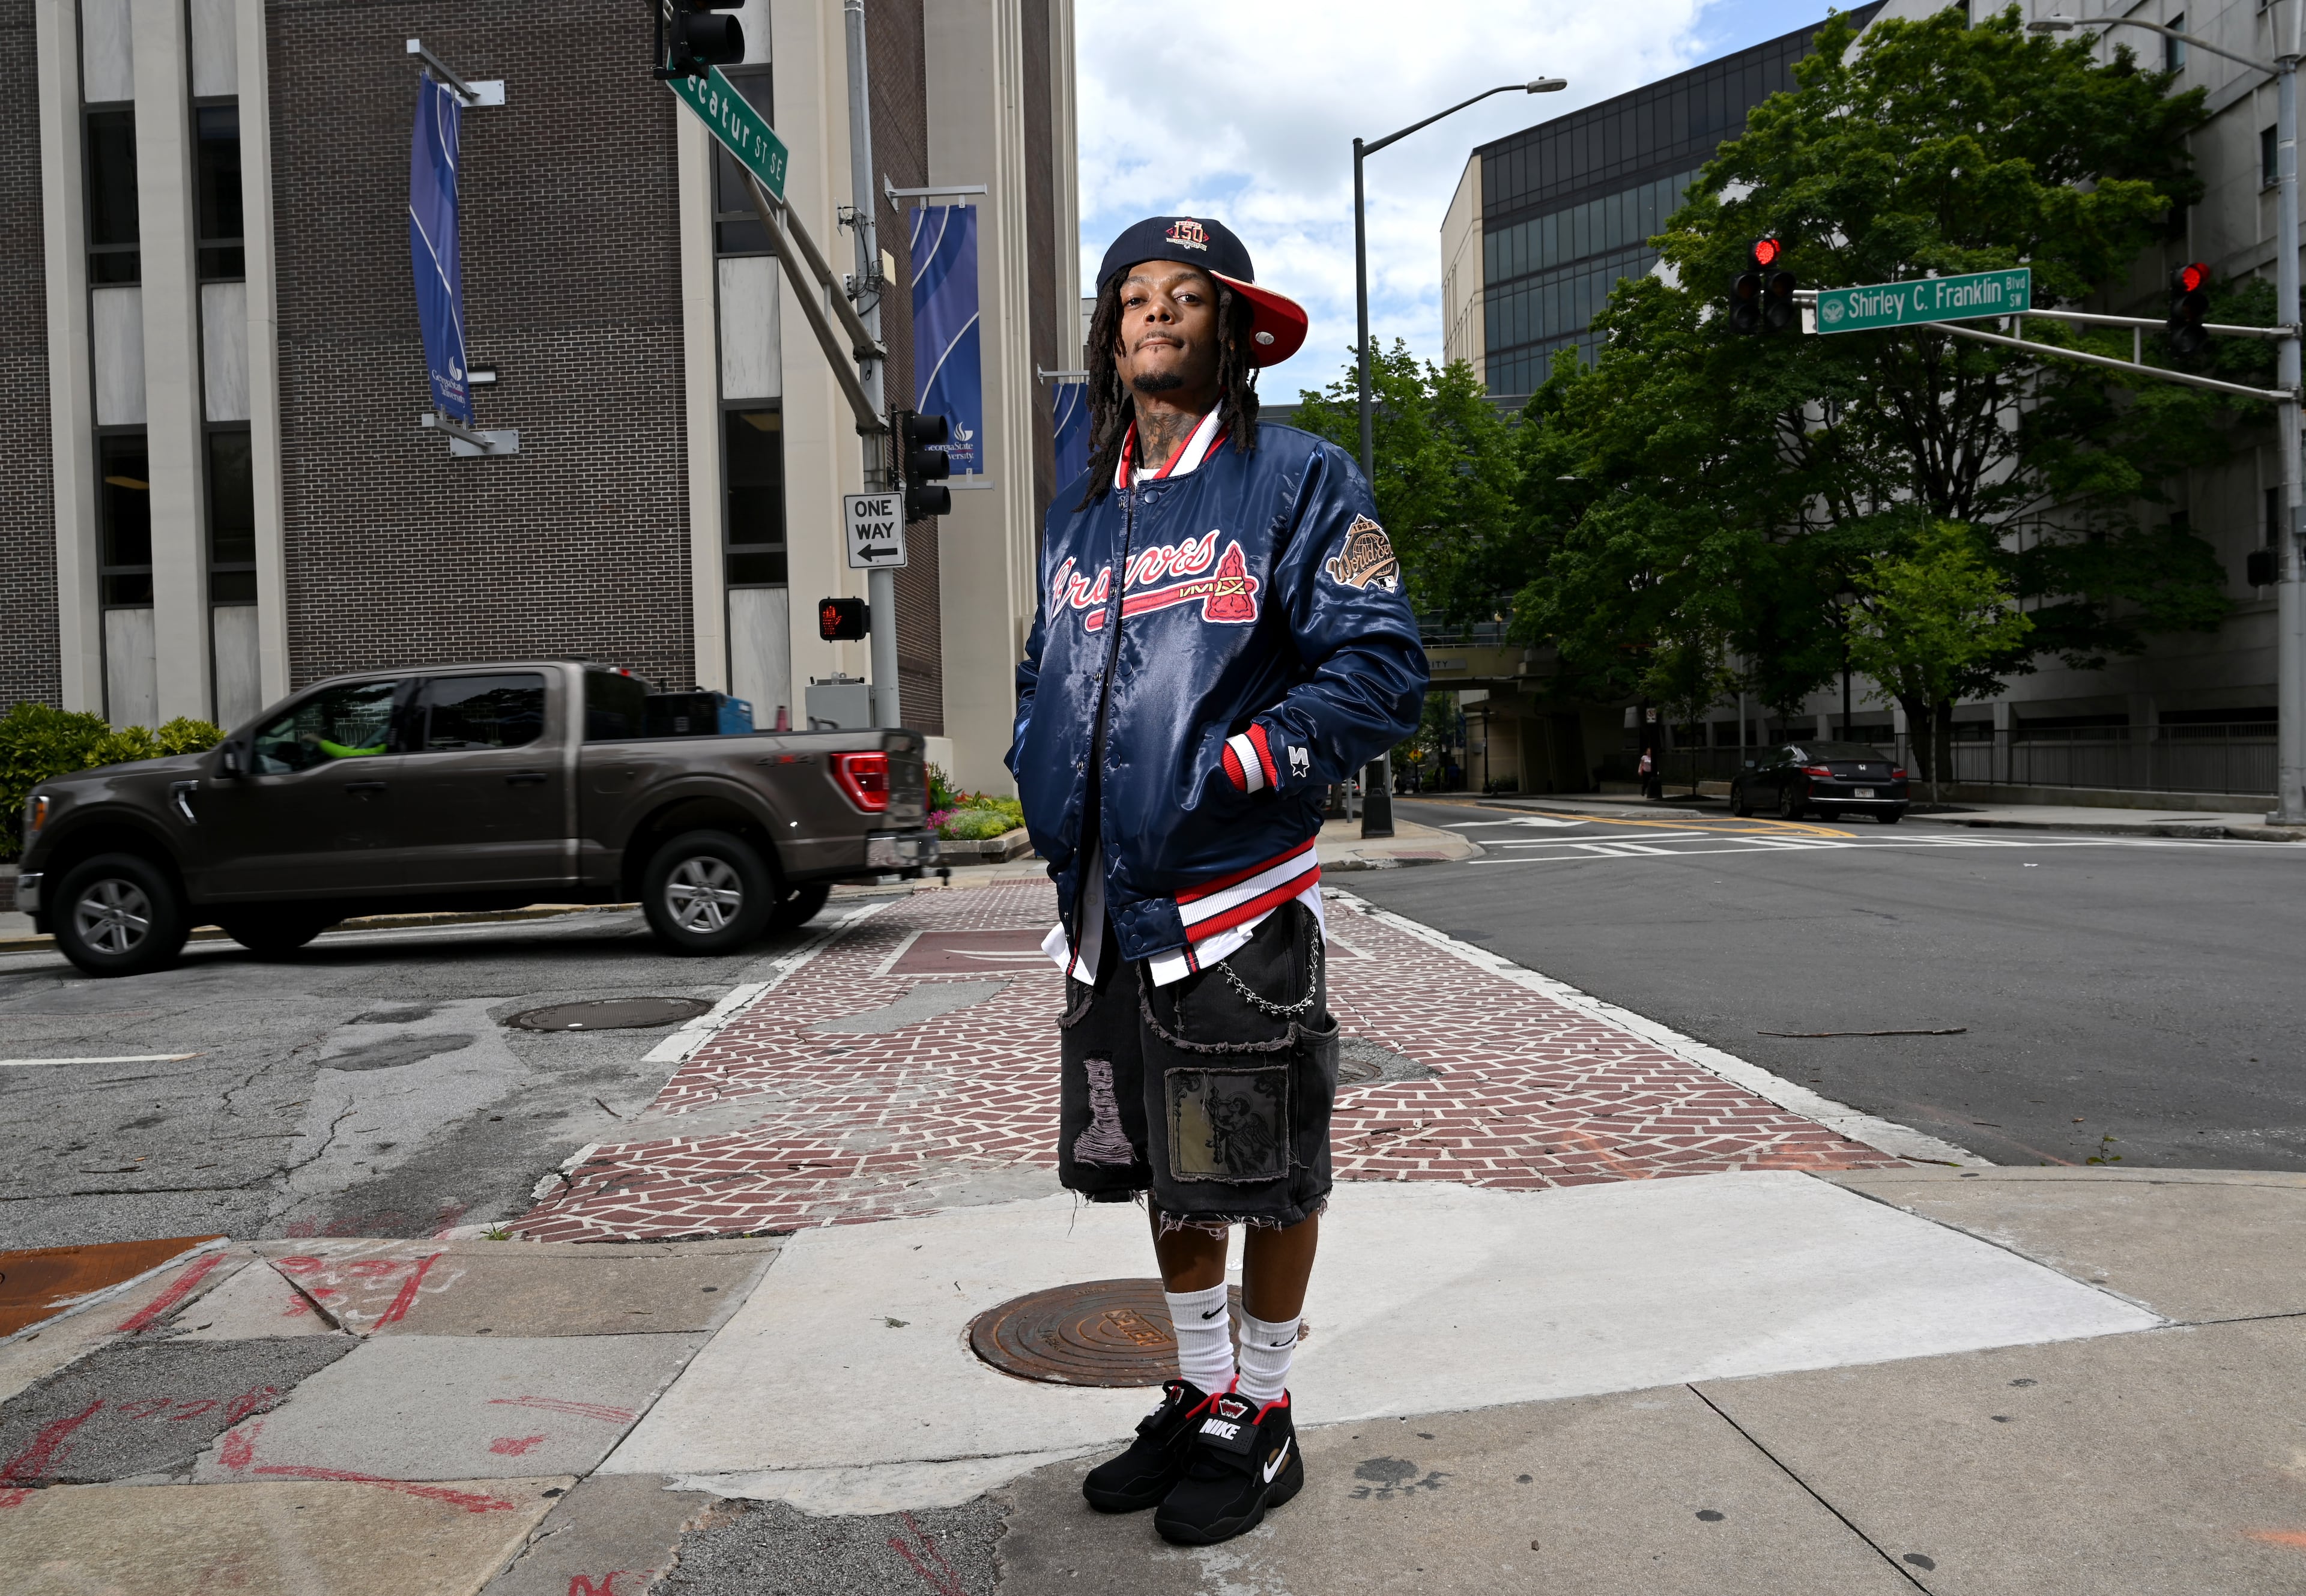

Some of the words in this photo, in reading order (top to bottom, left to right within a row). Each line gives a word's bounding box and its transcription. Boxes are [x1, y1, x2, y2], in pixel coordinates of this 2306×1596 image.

[688, 74, 749, 148] ecatur
[754, 135, 767, 164] ST
[770, 153, 782, 181] SE
[1172, 225, 1203, 243] 150
[1848, 290, 1905, 321] Shirley
[1913, 285, 1928, 311] C.
[1935, 277, 2002, 309] Franklin
[2006, 276, 2026, 291] Blvd
[2009, 292, 2022, 307] SW
[855, 500, 893, 518] ONE
[855, 522, 895, 540] WAY
[1353, 522, 1373, 532] 1995
[1328, 540, 1377, 582] World
[1104, 1309, 1169, 1346] SEWER
[1199, 1418, 1241, 1440] NIKE
